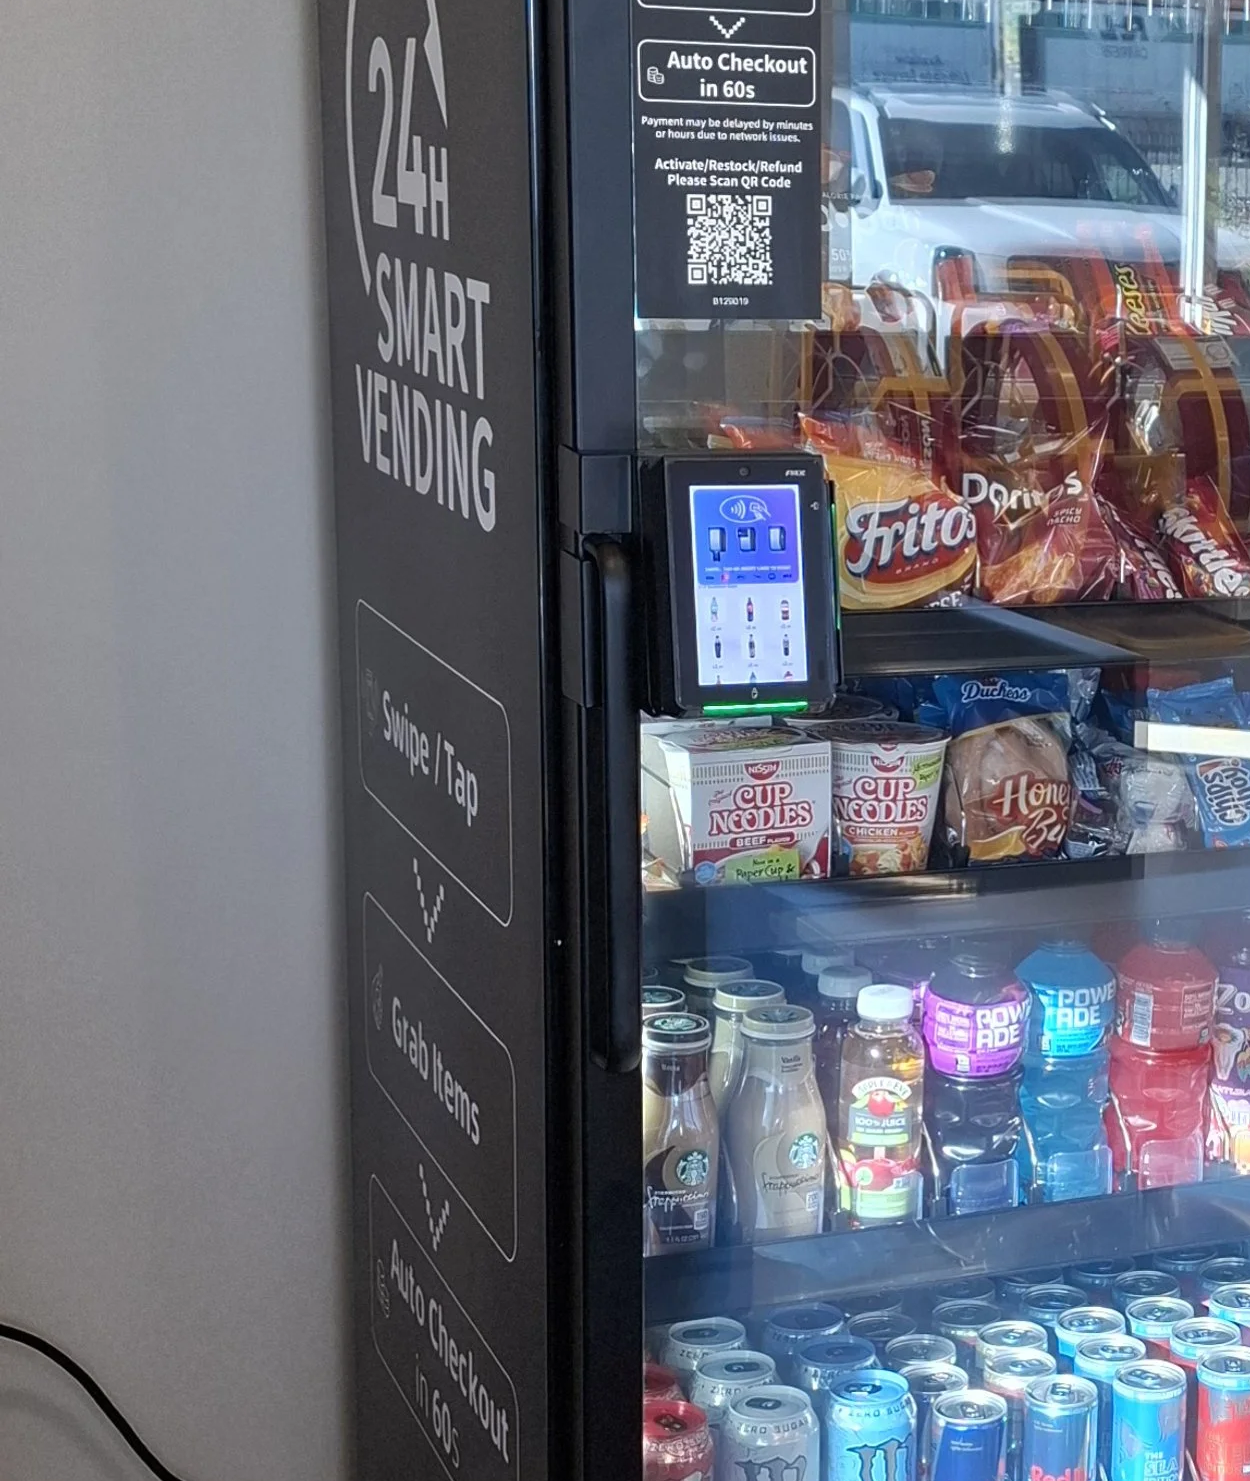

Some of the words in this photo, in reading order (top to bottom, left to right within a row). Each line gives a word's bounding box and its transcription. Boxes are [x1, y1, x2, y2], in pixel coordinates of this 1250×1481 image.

[667, 51, 713, 71] Auto
[718, 52, 808, 74] Checkout
[700, 78, 717, 97] in
[723, 80, 755, 99] 60s
[641, 116, 683, 128] Payment
[686, 119, 706, 129] may
[708, 117, 721, 127] be
[723, 118, 760, 130] delayed
[763, 119, 775, 130] by
[777, 120, 813, 131] minutes
[656, 130, 666, 138] or
[668, 129, 695, 140] hours
[697, 130, 716, 140] due
[718, 131, 727, 140] to
[730, 130, 767, 141] network
[770, 132, 801, 143] issues.
[368, 36, 450, 241] 24H
[655, 157, 803, 174] Activate/Restock/Refund
[667, 174, 707, 186] Please
[709, 175, 738, 187] Scan
[741, 176, 758, 189] QR
[761, 176, 791, 188] Code
[377, 252, 490, 400] SMART
[356, 363, 497, 533] VENDING
[845, 497, 976, 575] Fritos
[961, 680, 1031, 704] Duchess
[383, 689, 430, 777] Swipe
[434, 732, 442, 786] /
[444, 738, 479, 827] Tap
[734, 781, 793, 810] CUP
[853, 775, 917, 800] CUP
[708, 800, 813, 837] NOODLES
[832, 794, 929, 824] NOODLES
[736, 835, 767, 847] BEEF
[848, 826, 899, 836] CHICKEN
[764, 865, 785, 879] Cup
[1056, 1005, 1102, 1030] ADE
[976, 1024, 1021, 1049] ADE
[392, 996, 429, 1081] Grab
[433, 1042, 481, 1146] Items
[881, 1117, 906, 1127] JUICE
[391, 1238, 425, 1328] Auto
[429, 1297, 510, 1464] Checkout
[415, 1352, 429, 1418] in
[432, 1389, 461, 1469] 60s
